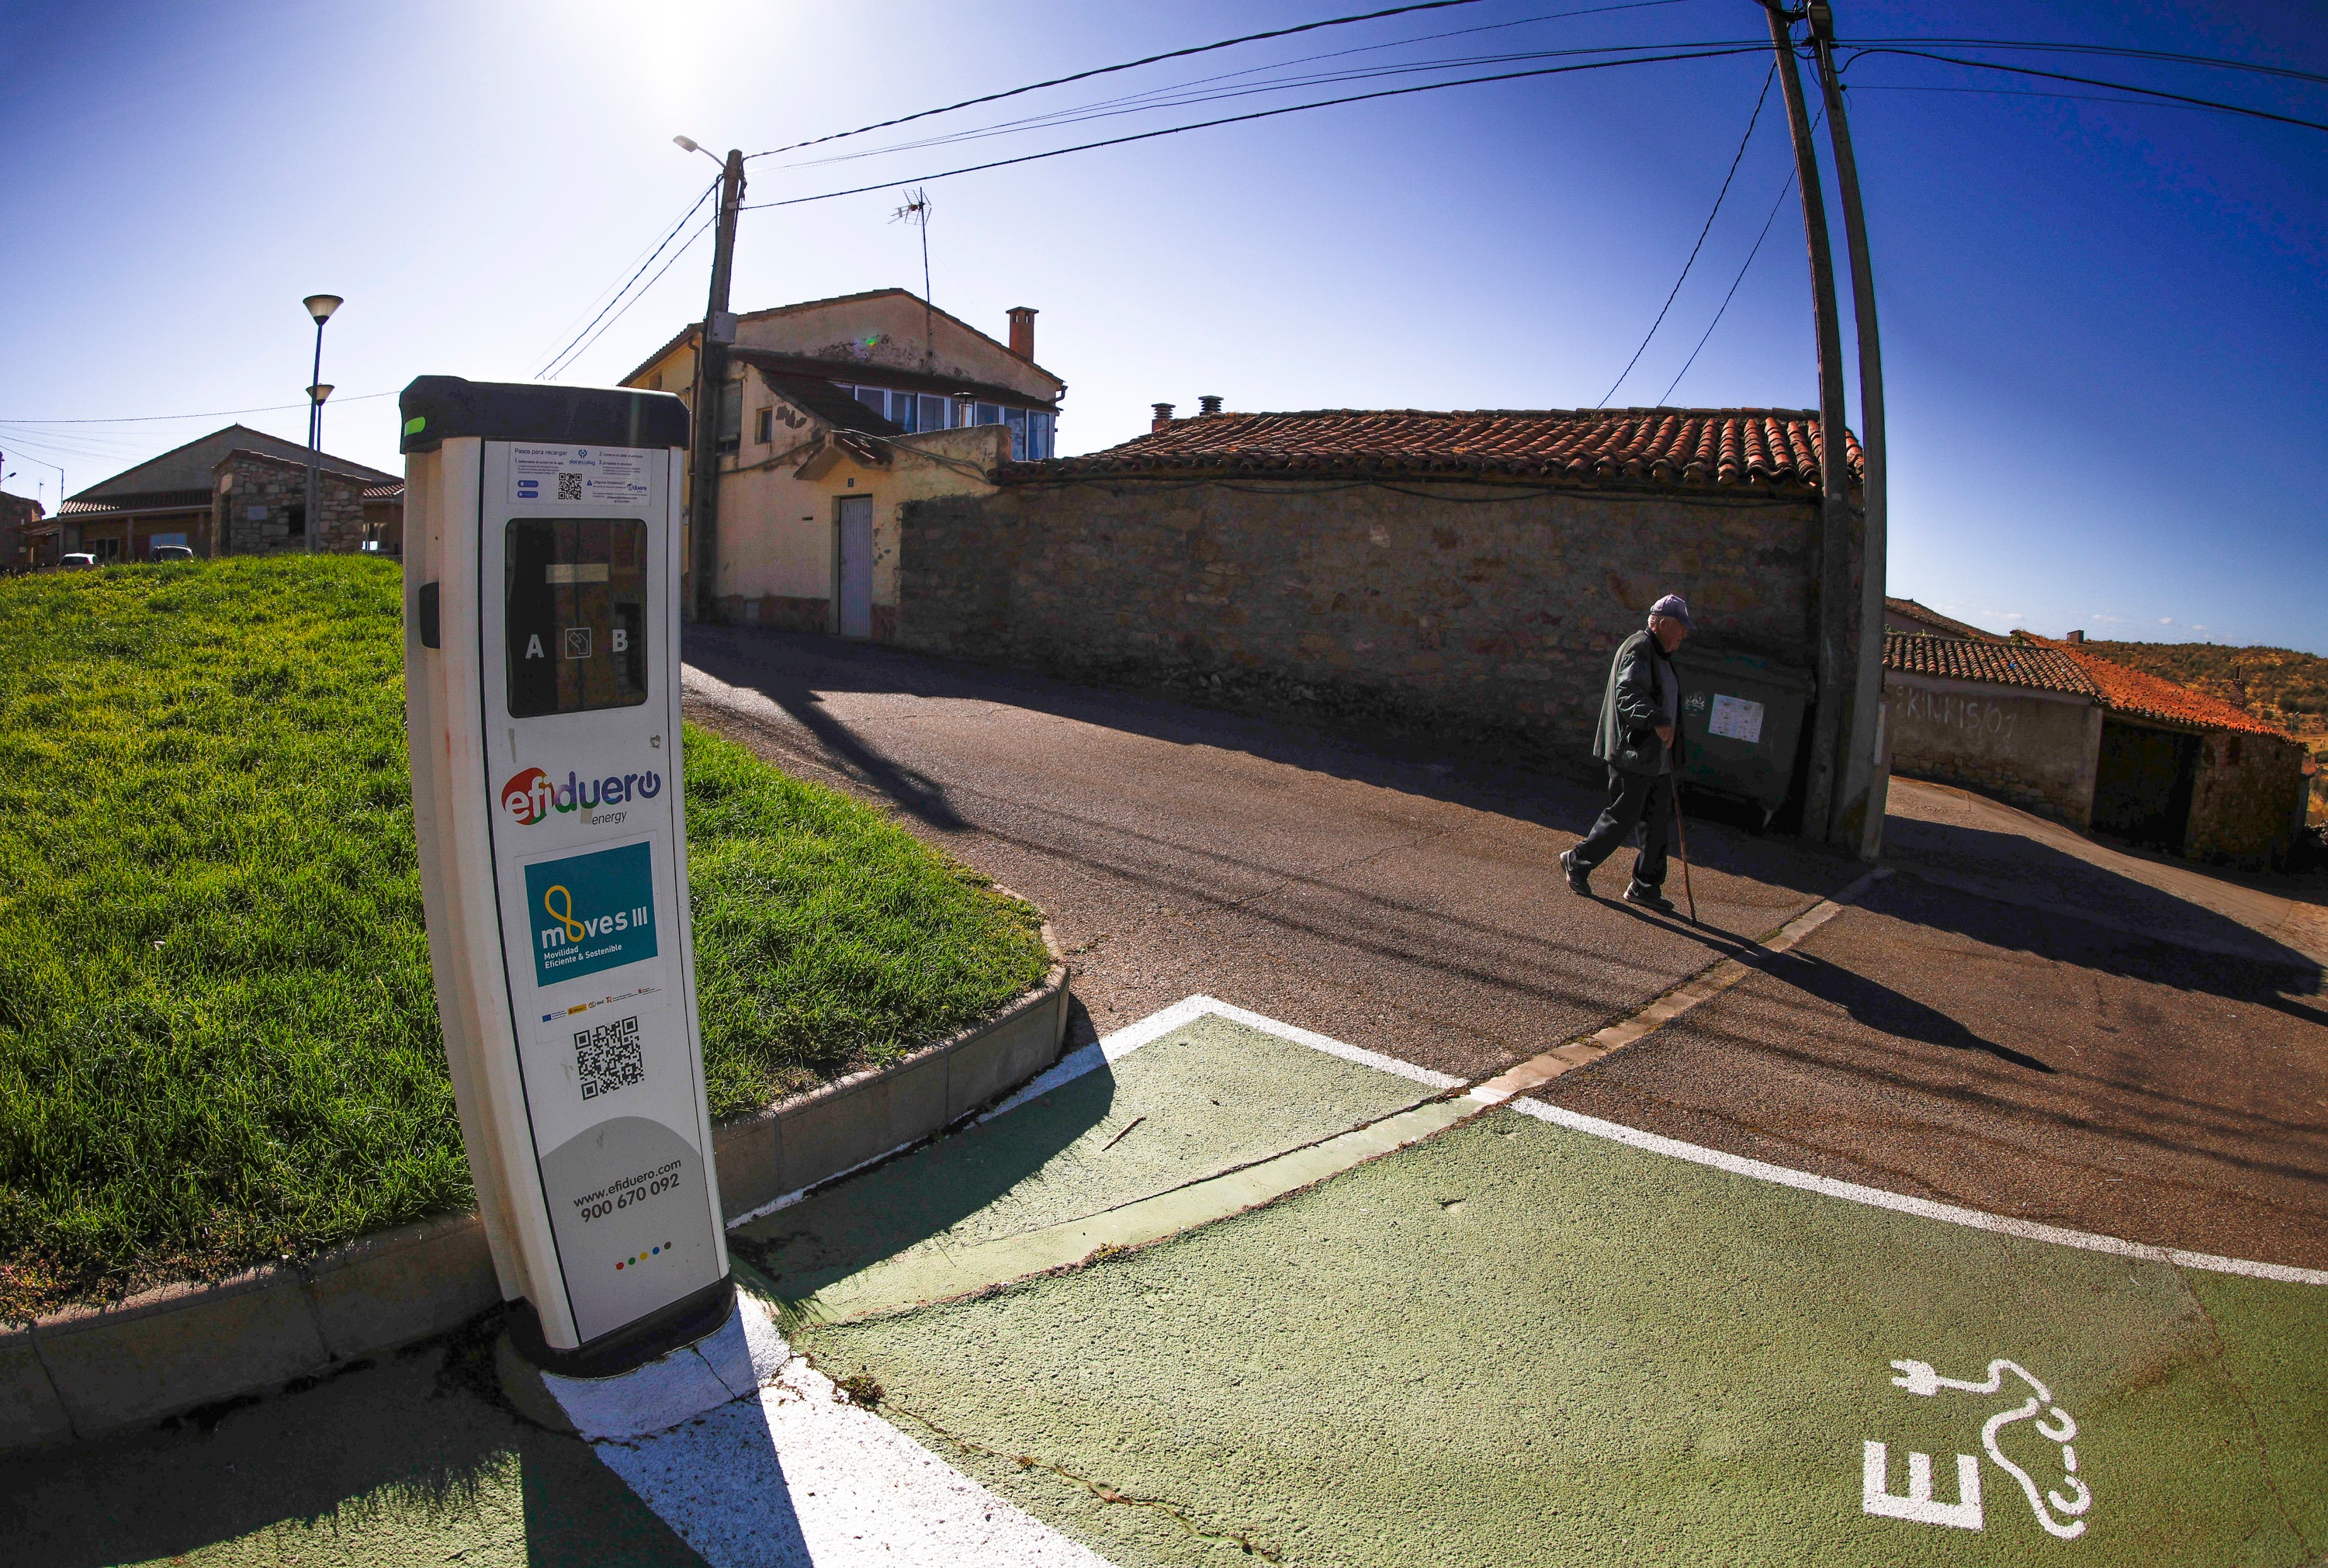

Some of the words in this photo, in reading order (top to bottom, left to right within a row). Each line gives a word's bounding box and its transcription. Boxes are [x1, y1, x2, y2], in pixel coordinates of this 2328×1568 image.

[525, 634, 544, 659] A
[612, 629, 629, 652] B
[504, 769, 661, 822] efiduero
[591, 811, 627, 825] energy
[632, 906, 648, 927] III
[544, 945, 579, 961] Movilidad
[545, 955, 577, 968] Eficiente
[578, 953, 584, 961] &
[585, 944, 622, 959] Sostenible
[573, 1159, 681, 1207] www.efiduero.com
[580, 1199, 613, 1223] 900
[617, 1186, 646, 1209] 670
[650, 1172, 680, 1196] 092
